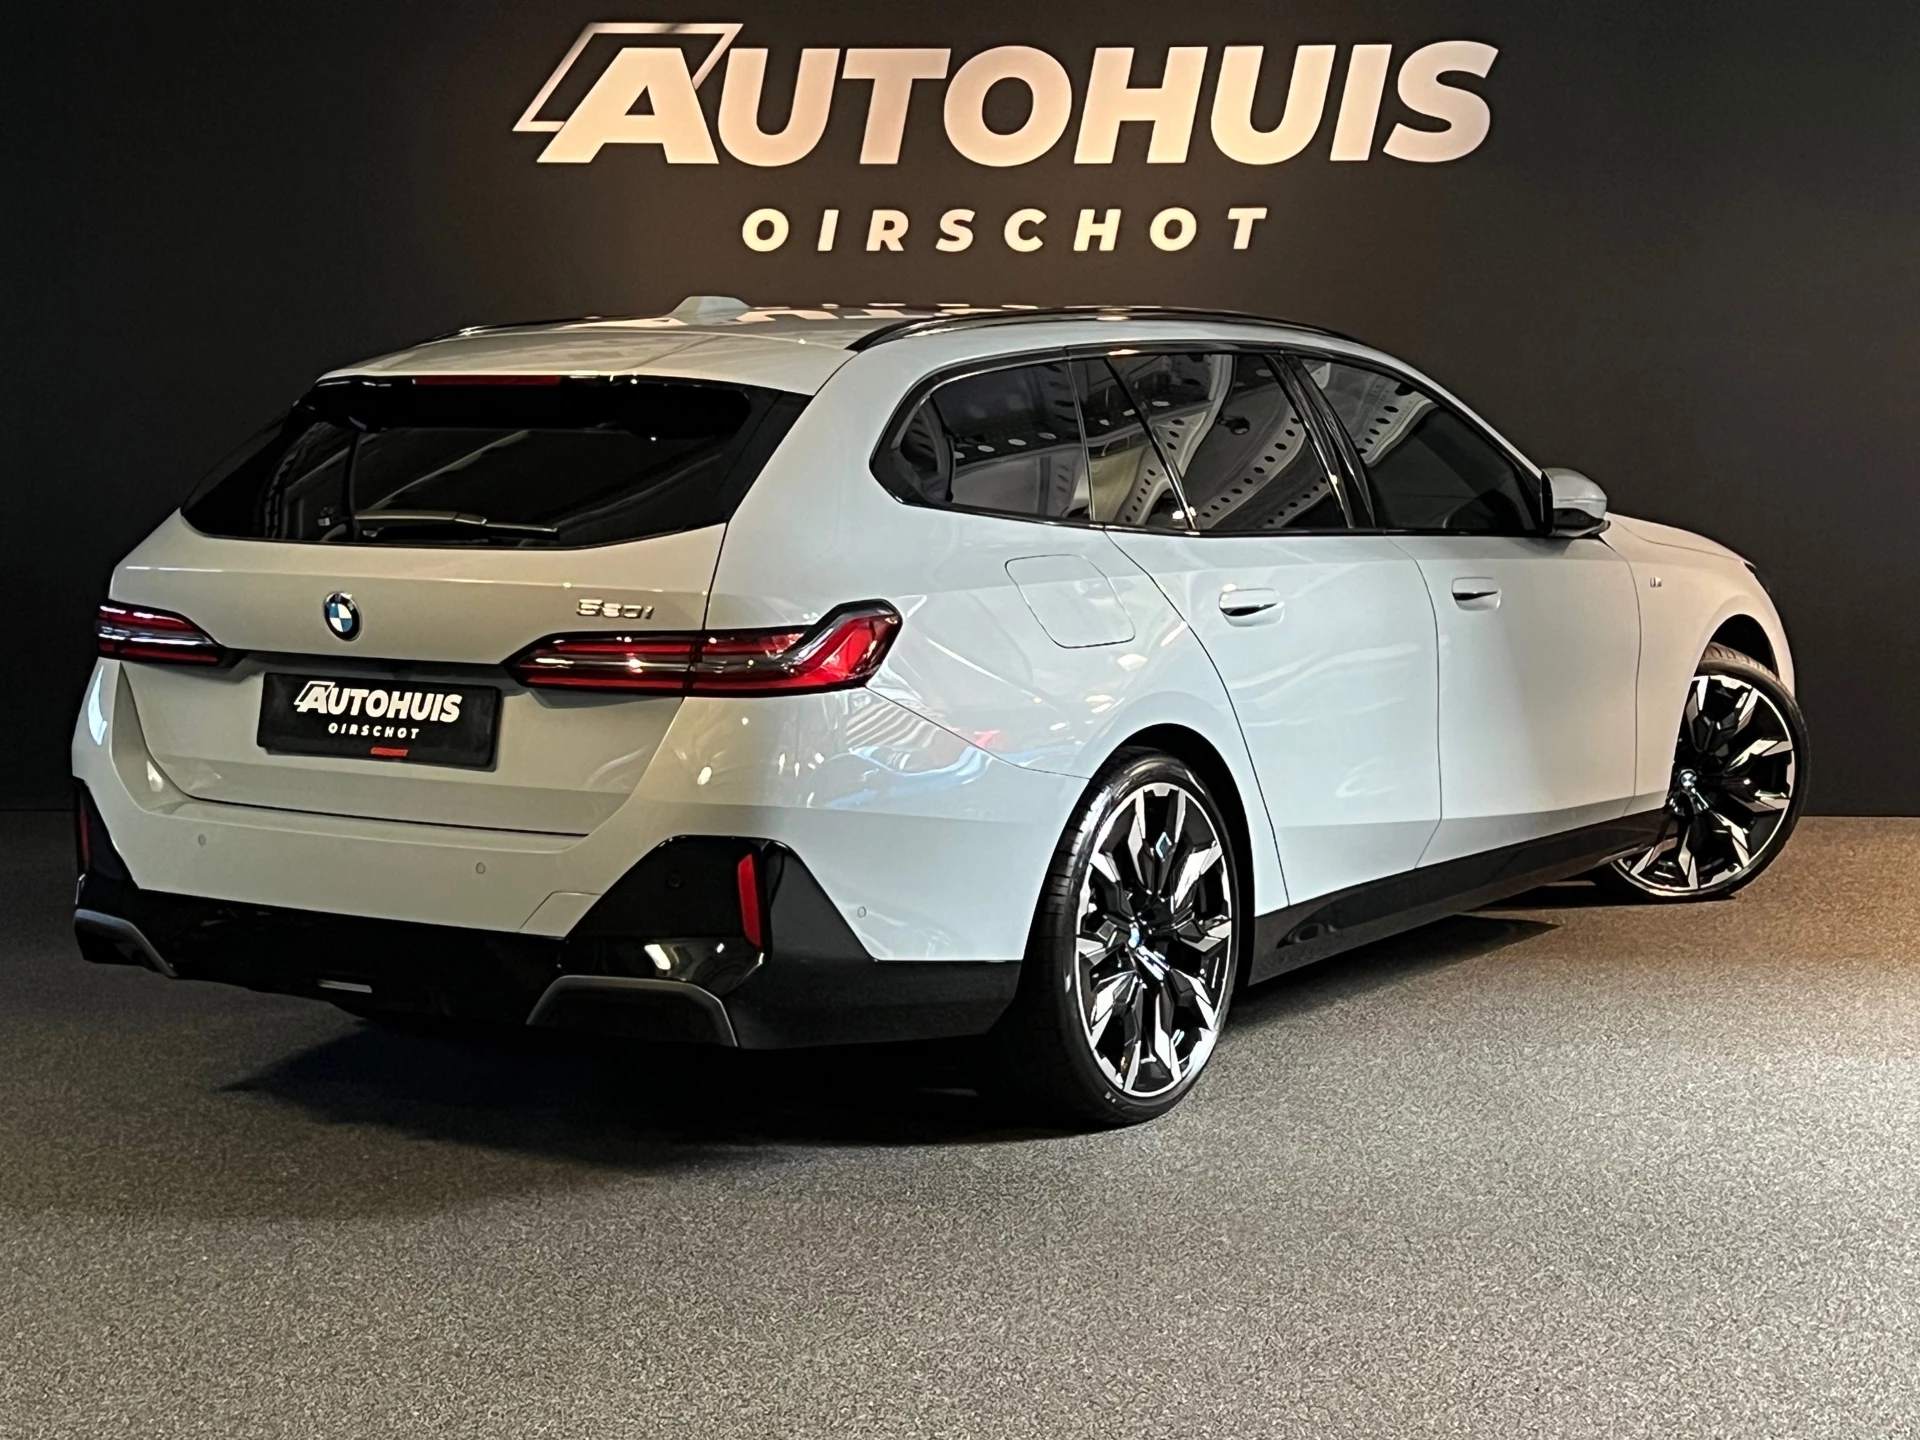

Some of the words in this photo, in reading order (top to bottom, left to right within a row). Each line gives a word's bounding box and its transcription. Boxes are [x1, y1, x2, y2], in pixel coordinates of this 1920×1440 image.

[536, 40, 1499, 168] AUTOHUIS
[741, 206, 1268, 252] OIRSCHOT
[296, 686, 463, 724] AUTOHUIS
[327, 722, 420, 740] OIRSCHOT
